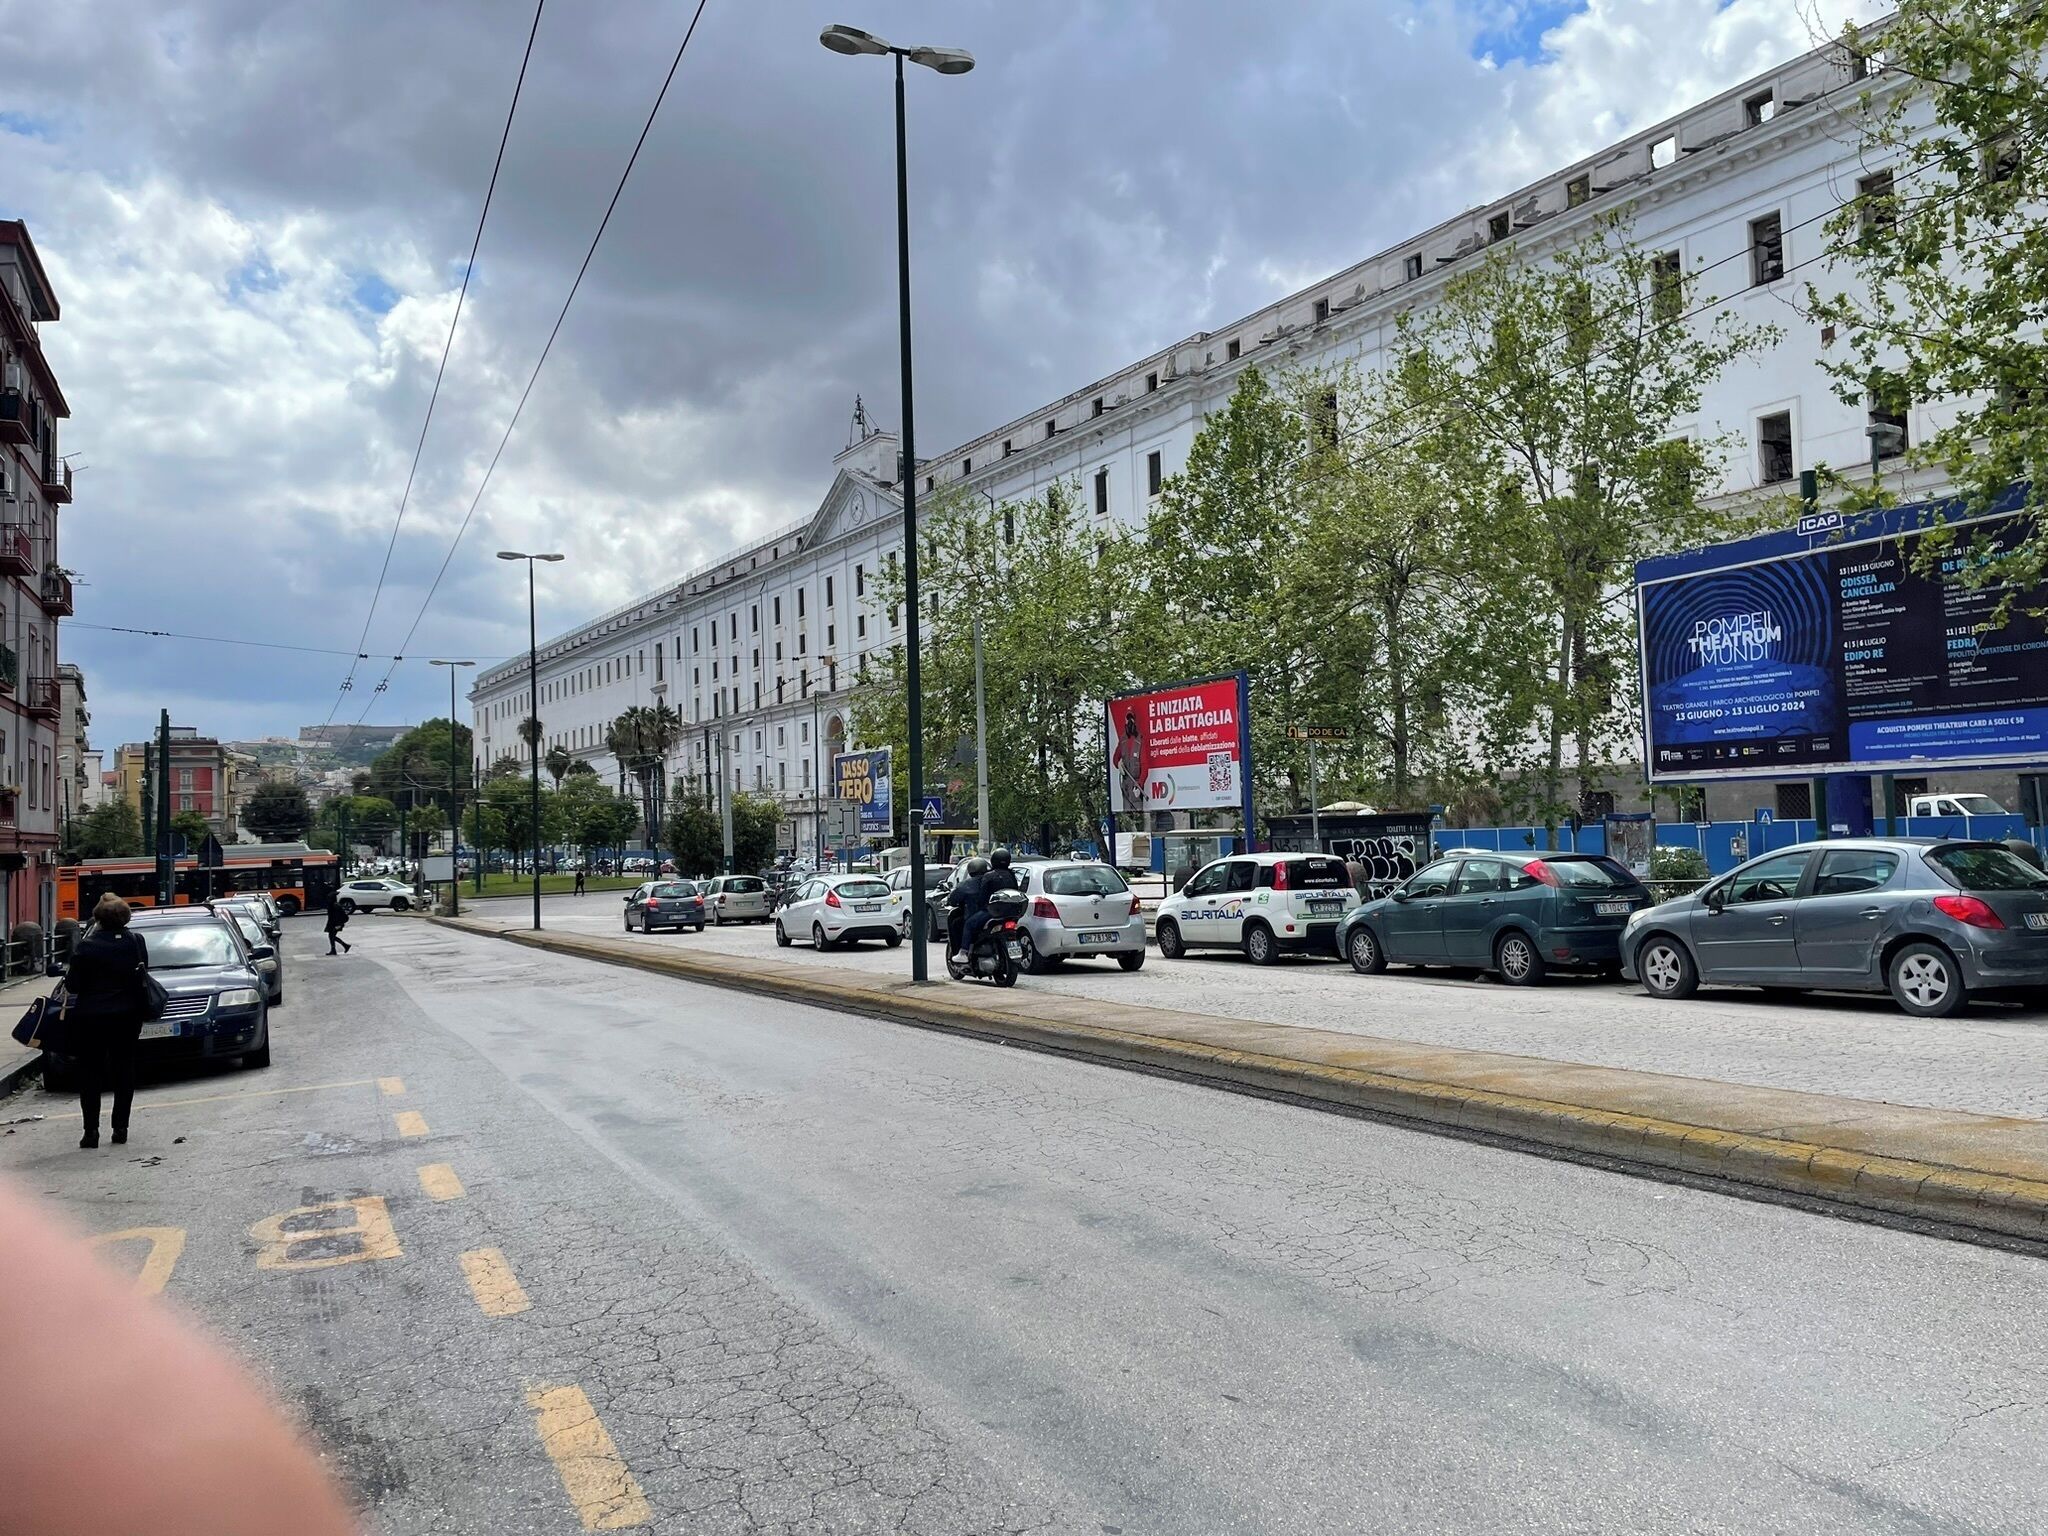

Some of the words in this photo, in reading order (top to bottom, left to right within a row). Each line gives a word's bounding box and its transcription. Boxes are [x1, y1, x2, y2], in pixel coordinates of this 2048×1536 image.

[1802, 514, 1837, 530] ICAP
[1839, 567, 1847, 575] 13
[1869, 559, 1895, 570] GIUGNO
[1942, 561, 1955, 572] DE
[1840, 574, 1877, 588] ODISSEA
[1841, 582, 1896, 598] CANCELLATA
[1695, 610, 1771, 639] POMPEII
[1688, 625, 1781, 653] THEATRUM
[1864, 637, 1886, 646] LUGLIO
[1947, 638, 1977, 650] FEDRA
[1699, 641, 1768, 667] MUNDI
[1844, 650, 1871, 661] EDIPO
[1872, 648, 1884, 658] RE
[1977, 645, 2012, 656] ORTATORE
[2021, 641, 2048, 650] CORON
[1149, 700, 1155, 717] È
[1156, 695, 1203, 716] INIZIATA
[1662, 703, 1684, 711] TEATRO
[1685, 701, 1709, 709] GRANDE
[1713, 698, 1733, 706] PARCO
[1734, 692, 1785, 704] ARCHEOLOGICO
[1794, 689, 1820, 698] POMPEI
[1676, 712, 1685, 721] 13
[1687, 709, 1723, 720] GIUGNO
[1732, 707, 1742, 716] 13
[1744, 703, 1779, 715] LUGLIO
[1781, 700, 1805, 711] 2024
[1149, 719, 1163, 734] LA
[1164, 709, 1233, 732] BLATTAGLIA
[1877, 725, 1906, 734] ACQUISTA
[1933, 720, 1968, 730] THEATRUM
[1969, 719, 1986, 727] CARD
[1988, 718, 1993, 726] A
[1994, 717, 2009, 725] SOLI
[1150, 737, 1169, 746] Liberati
[841, 759, 869, 779] TASSO
[839, 777, 872, 804] ZERO
[1151, 782, 1168, 799] MD
[1386, 825, 1406, 833] TOILETTE
[1181, 909, 1245, 920] SICURITALIA
